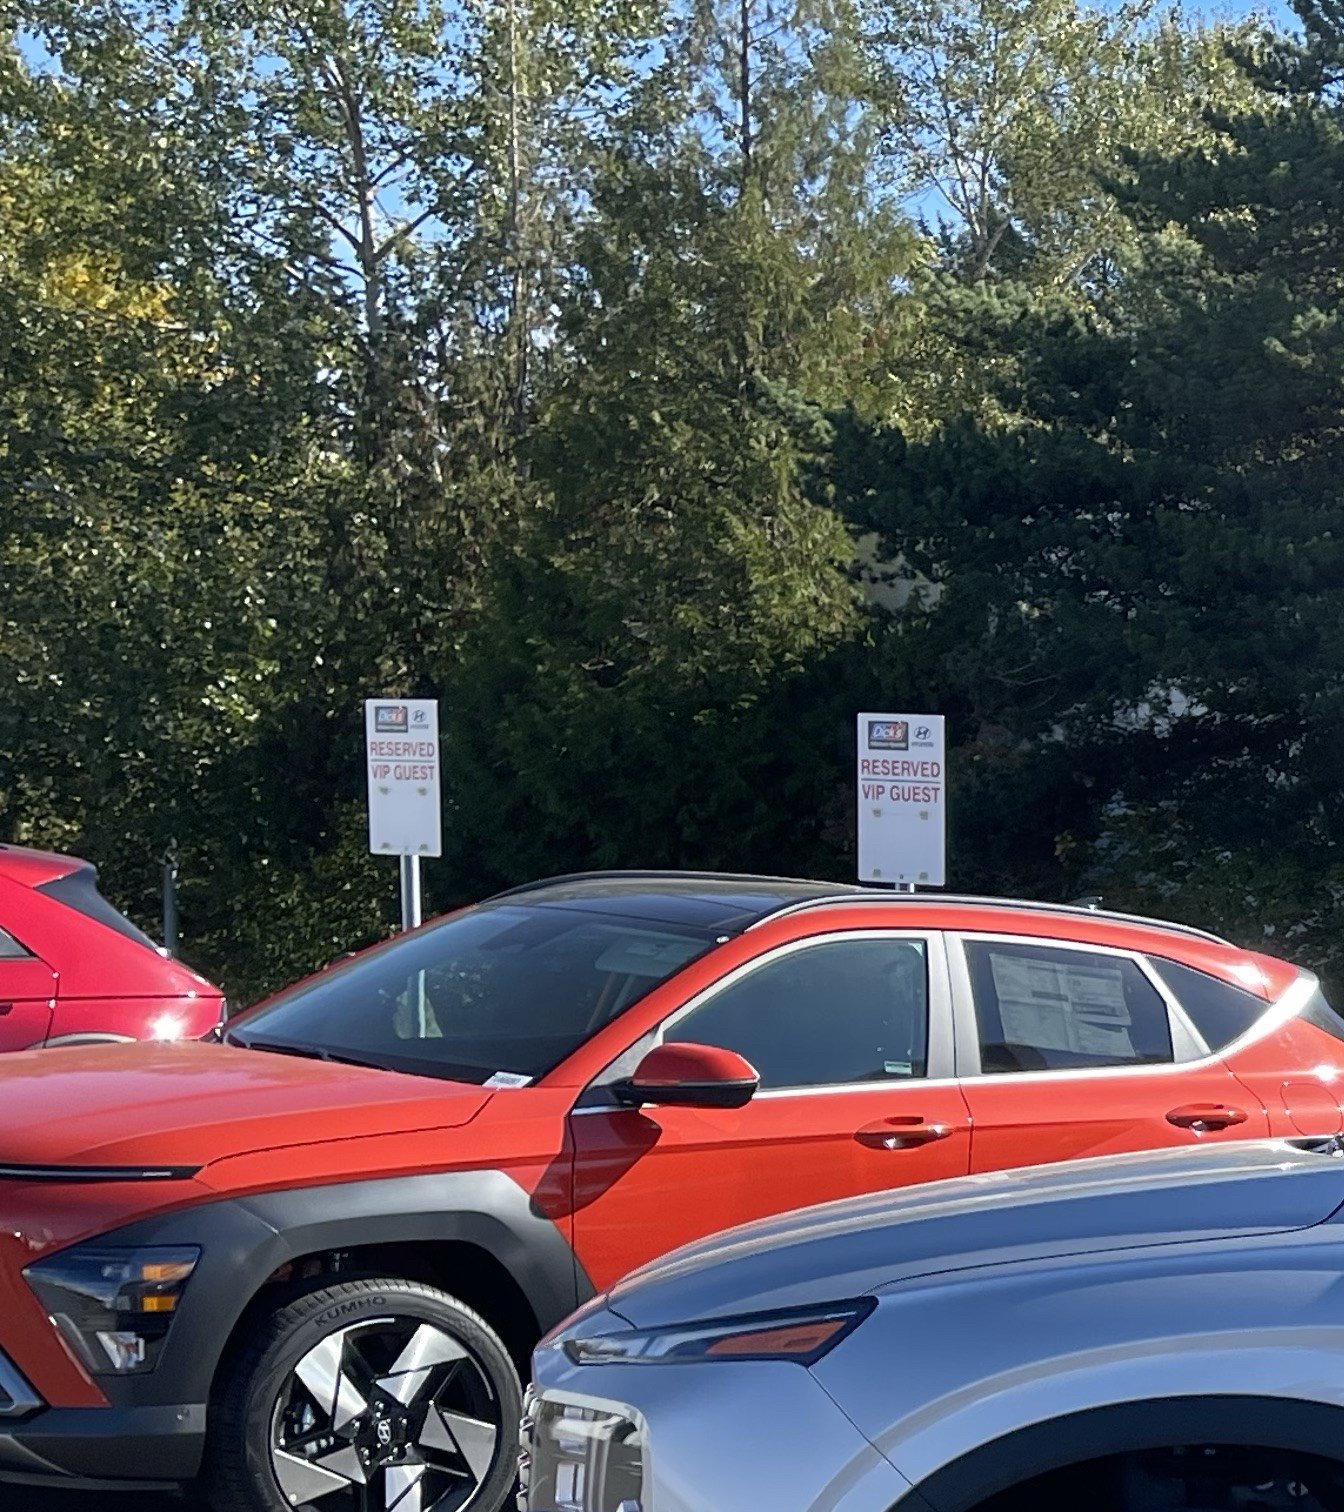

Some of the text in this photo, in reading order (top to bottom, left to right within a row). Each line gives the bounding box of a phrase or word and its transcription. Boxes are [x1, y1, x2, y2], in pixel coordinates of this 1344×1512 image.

[369, 741, 435, 758] RESERVED
[371, 764, 435, 781] VIP GUEST
[860, 759, 941, 778] RESERVED
[862, 784, 941, 804] VIP GUEST
[313, 1296, 388, 1329] KUMHO
